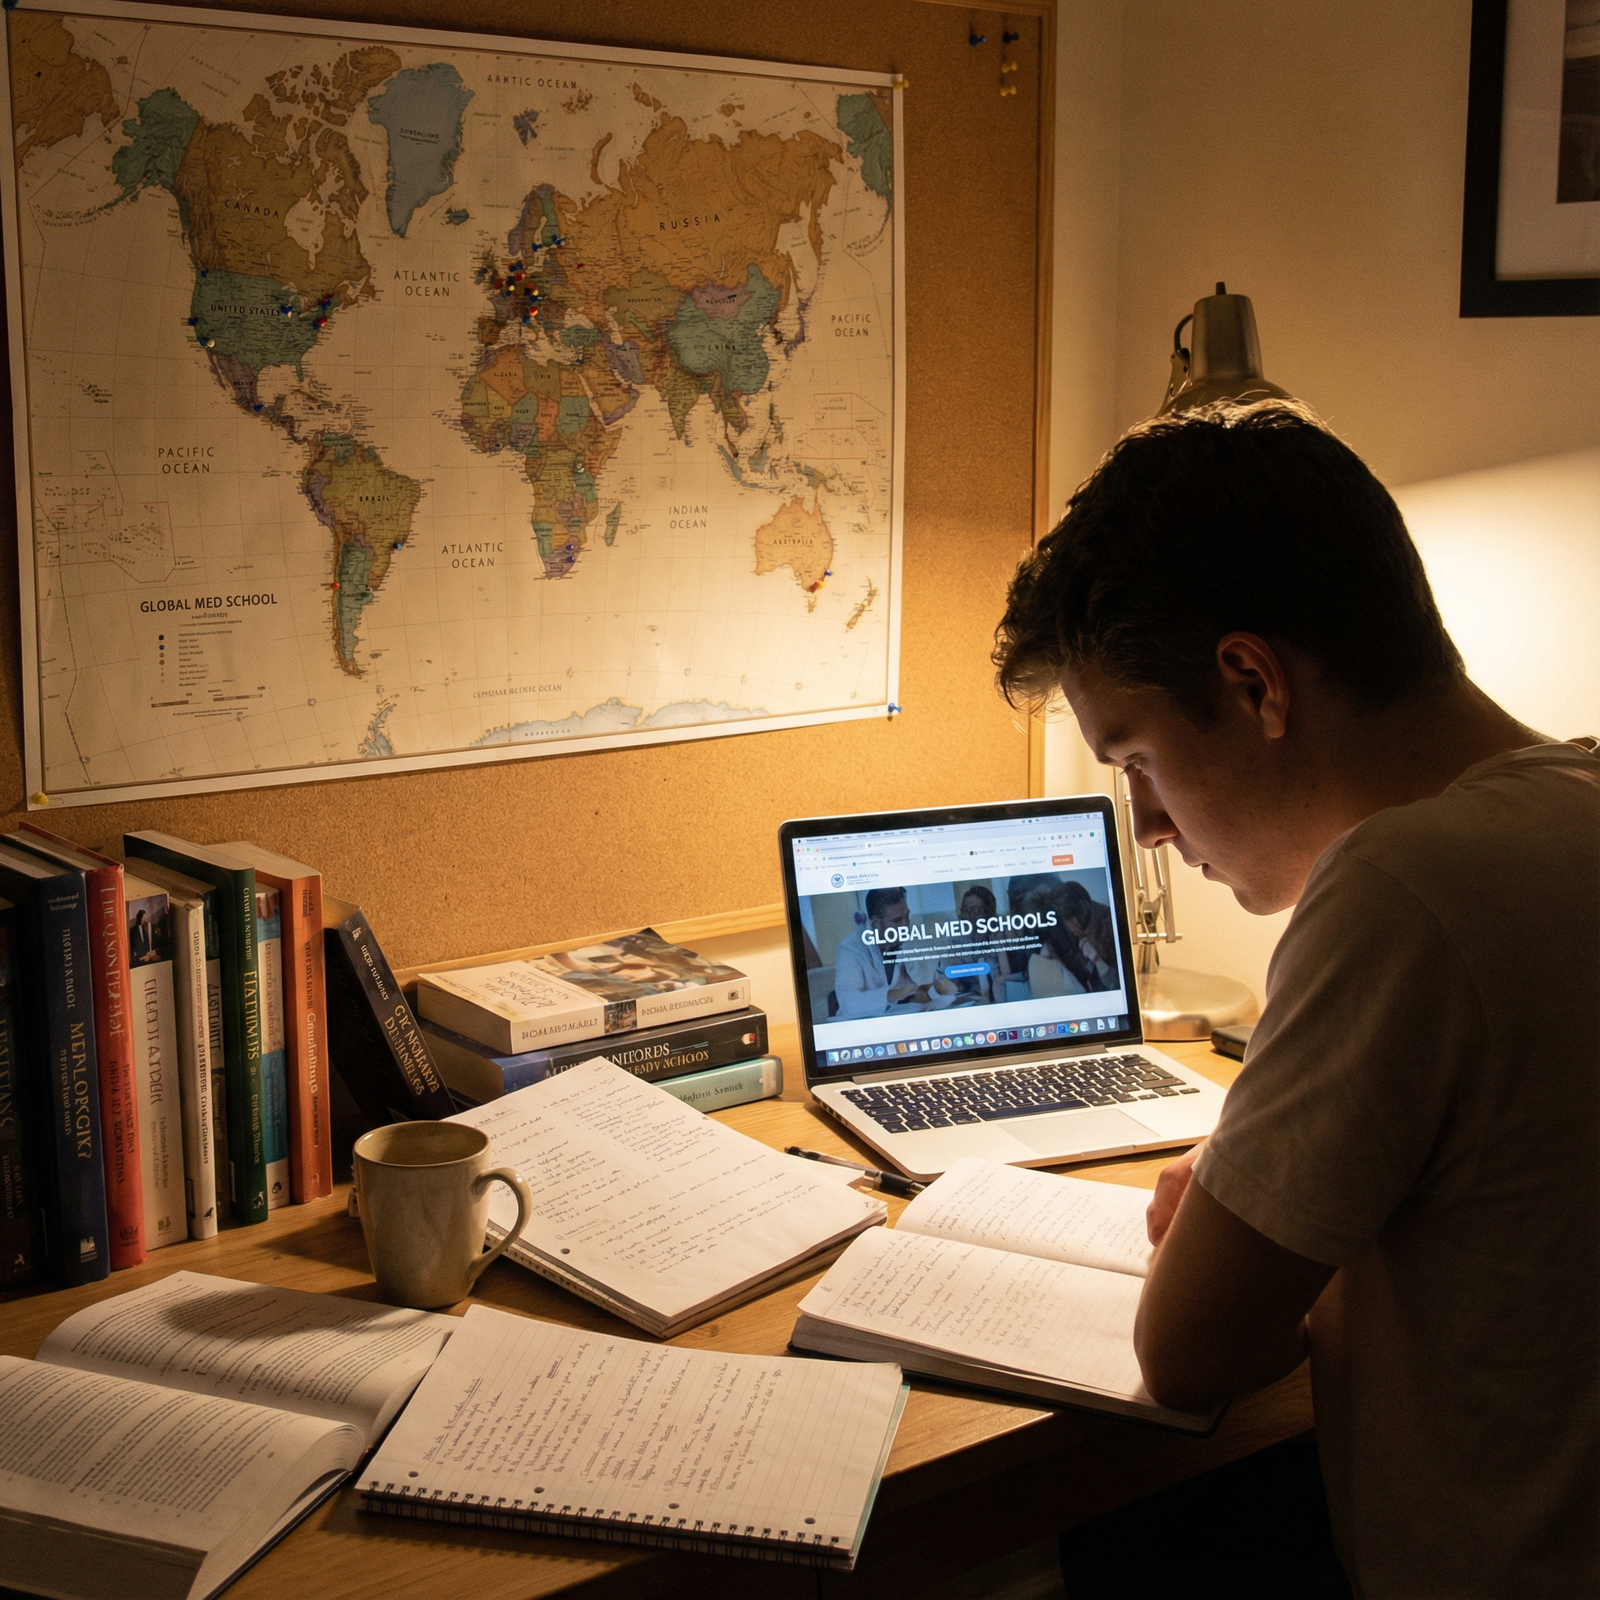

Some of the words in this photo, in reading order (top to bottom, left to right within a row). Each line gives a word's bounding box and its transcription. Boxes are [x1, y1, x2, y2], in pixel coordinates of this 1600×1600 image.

[538, 78, 578, 89] OCEAN
[224, 199, 279, 219] CANADA
[659, 214, 721, 231] RUSSIA
[394, 270, 461, 282] ATLANTIC
[405, 286, 450, 297] OCEAN
[210, 304, 246, 314] UNITED
[249, 307, 281, 316] STATES
[831, 314, 872, 325] PACIFIC
[834, 327, 869, 338] OCEAN
[157, 446, 215, 459] PACIFIC
[162, 462, 211, 475] OCEAN
[668, 504, 709, 516] INDIAN
[669, 518, 708, 529] OCEAN
[441, 541, 504, 555] ATLANTIC
[451, 556, 496, 569] OCEAN
[140, 599, 192, 613] GLOBAL
[194, 597, 223, 609] MED
[226, 593, 278, 608] SCHOOL
[861, 923, 933, 946] GLOBAL
[935, 919, 973, 939] MED
[976, 911, 1058, 935] SCHOOLS
